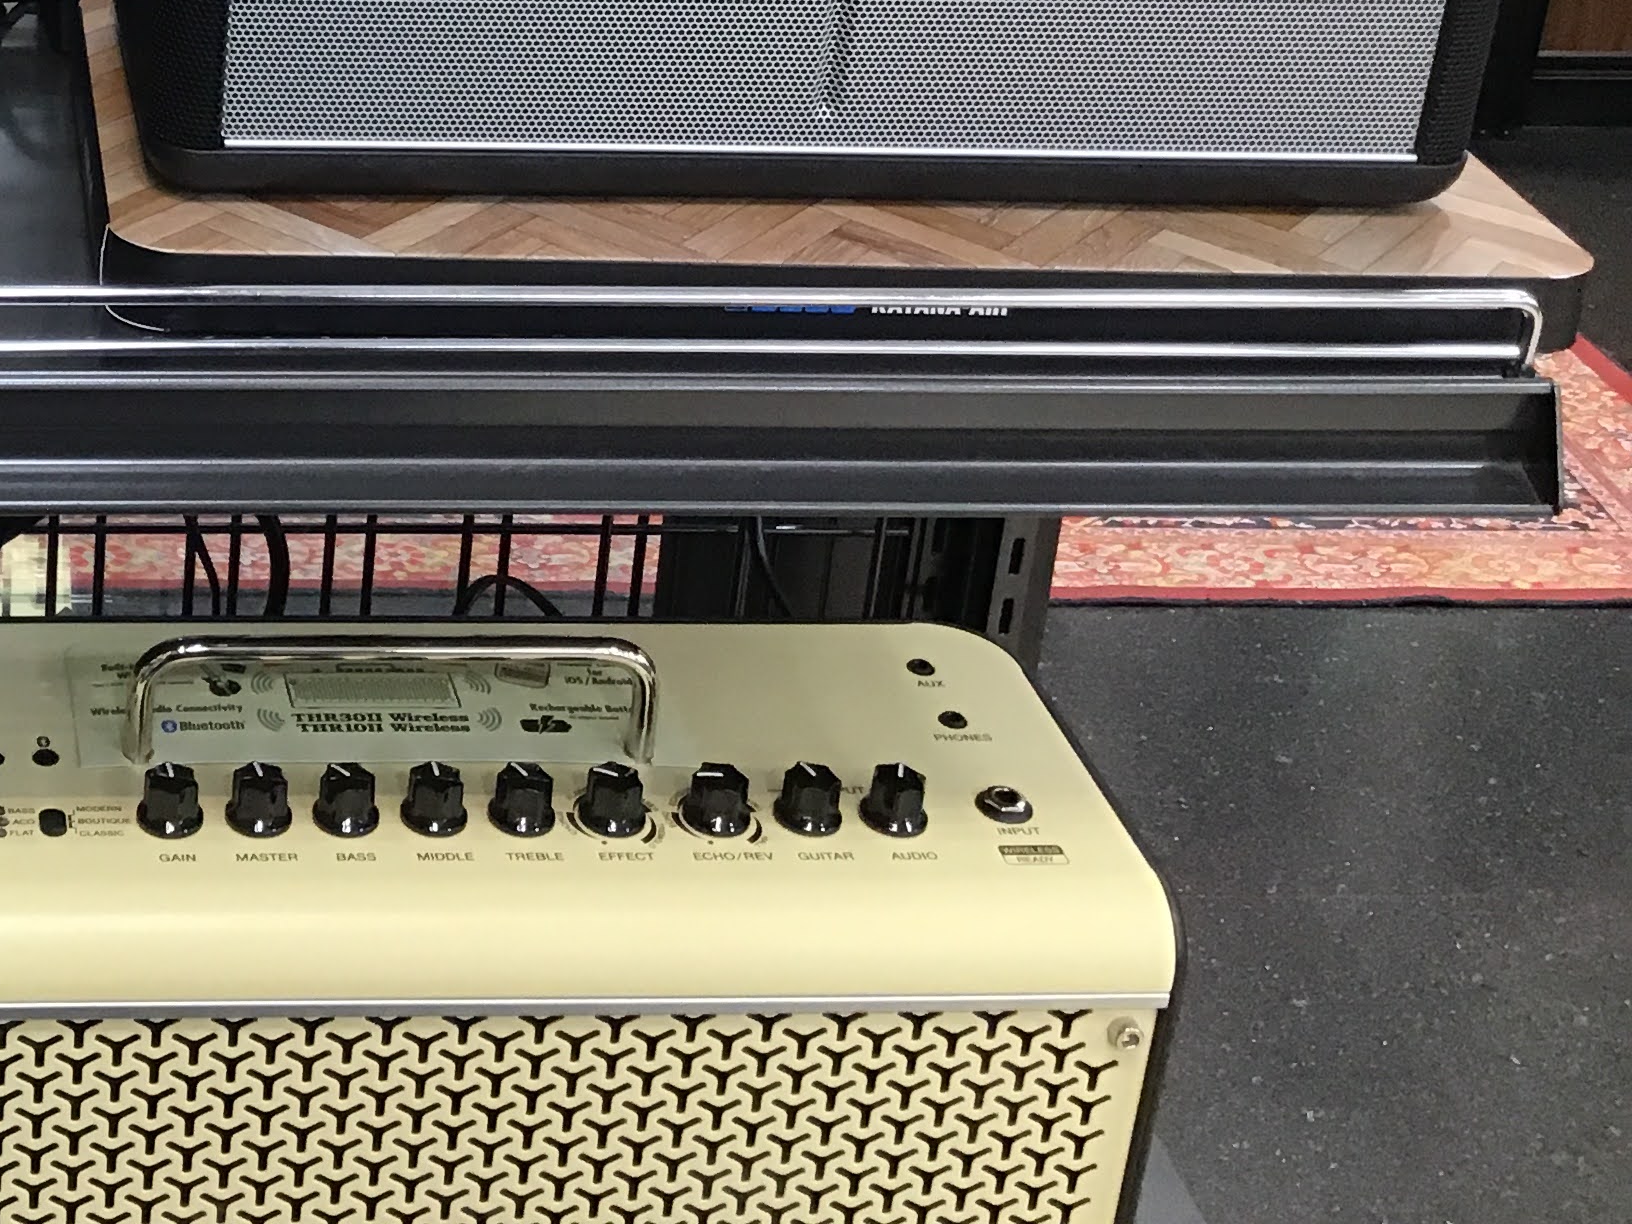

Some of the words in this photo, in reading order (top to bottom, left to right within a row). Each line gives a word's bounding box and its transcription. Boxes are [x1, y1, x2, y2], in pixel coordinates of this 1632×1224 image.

[917, 680, 945, 688] AUX
[389, 713, 469, 722] Wireless
[180, 720, 245, 731] Bluetooth
[390, 723, 470, 732] Wireless
[933, 733, 992, 742] PHONES
[76, 805, 122, 813] MODERN
[9, 829, 34, 837] FLAT
[997, 827, 1041, 836] INPUT
[159, 853, 196, 862] GAIN
[235, 852, 298, 862] MASTER
[336, 852, 377, 862] BASS
[416, 852, 475, 862] MIDDLE
[505, 852, 565, 862] TREBLE
[599, 852, 655, 862] EFFECT
[693, 852, 773, 862] ECHO/REV
[798, 852, 855, 861] GUITAR
[892, 852, 939, 861] AUDIO
